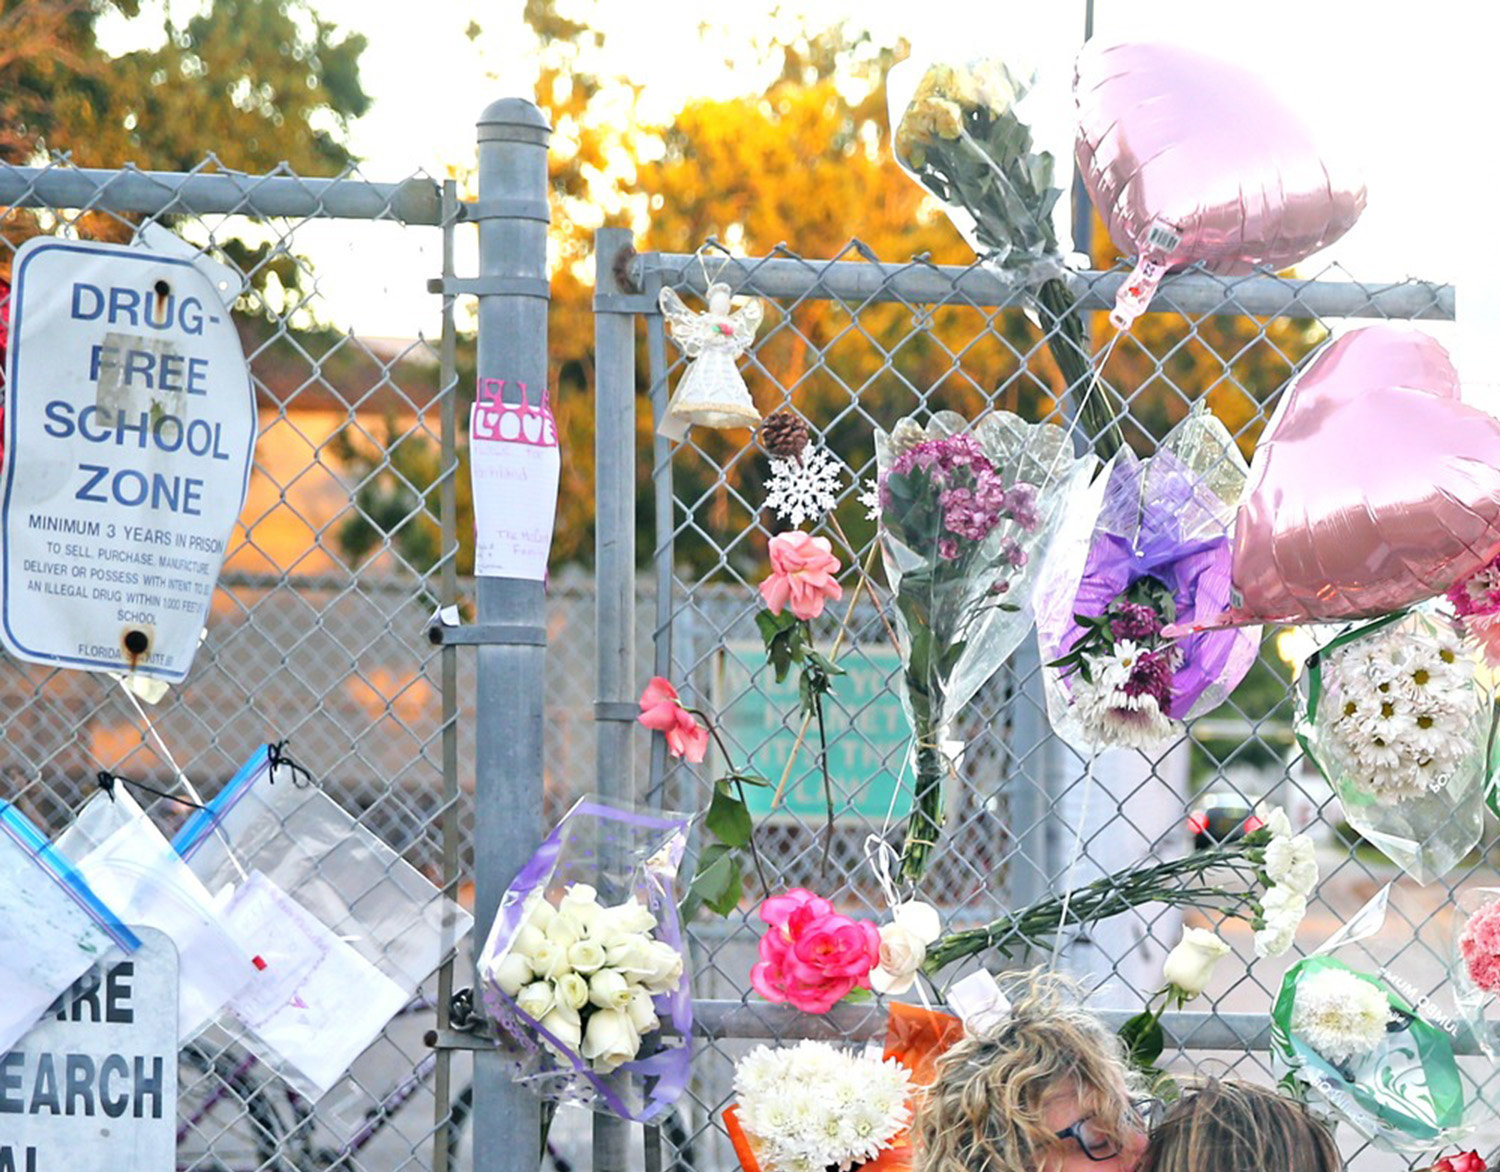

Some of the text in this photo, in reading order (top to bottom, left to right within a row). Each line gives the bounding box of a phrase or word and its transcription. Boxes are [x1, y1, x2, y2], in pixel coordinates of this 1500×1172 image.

[71, 282, 220, 336] DRUG-
[90, 345, 209, 396] FREE
[44, 400, 230, 460] SCHOOL
[475, 408, 558, 445] LOVE
[75, 463, 204, 515] ZONE
[28, 514, 224, 555] MINIMUM 3 YEARS IN PRISON
[47, 541, 62, 554] TO
[24, 559, 68, 576] DELIVER
[71, 565, 87, 578] OR
[90, 568, 139, 585] POSSESS
[143, 573, 166, 588] WITH
[27, 580, 42, 592] AN
[44, 582, 88, 599] ILLEGAL
[93, 587, 122, 602] DRUG
[126, 591, 161, 607] WITHIN
[117, 609, 157, 626] SCHOOL
[78, 643, 122, 659] FLORIDA
[0, 1051, 163, 1120] EARCH
